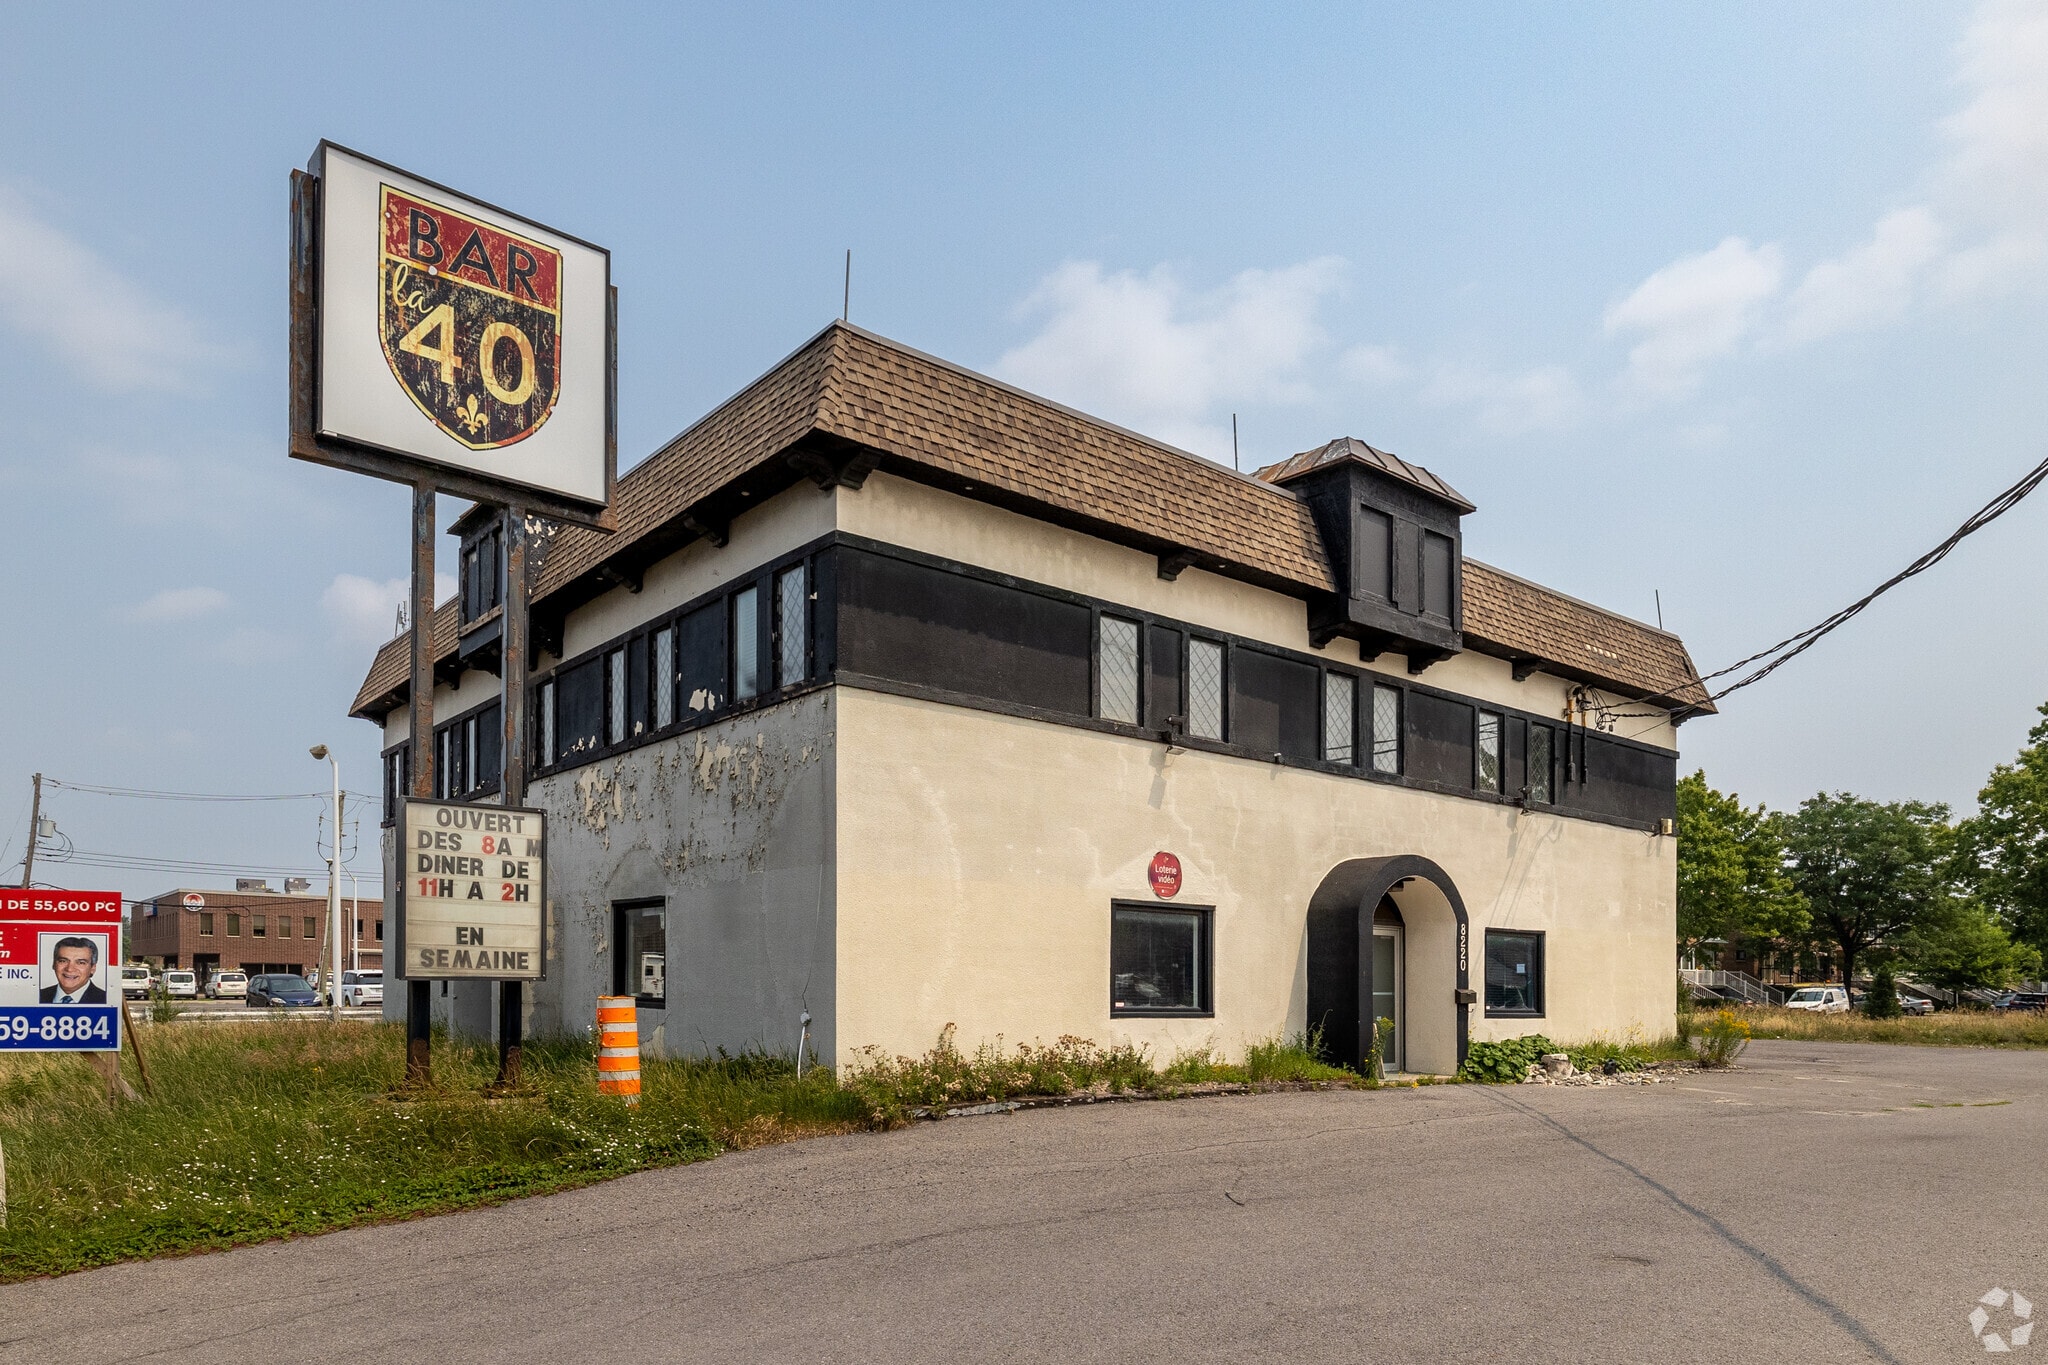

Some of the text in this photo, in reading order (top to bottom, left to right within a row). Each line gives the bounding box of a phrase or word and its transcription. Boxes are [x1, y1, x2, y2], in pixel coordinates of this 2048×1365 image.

[408, 207, 542, 304] BAR
[392, 263, 434, 314] la
[399, 303, 536, 405] 40
[436, 807, 525, 834] OUVERT
[417, 829, 462, 852] DES
[417, 853, 529, 879] DINER DE
[1154, 863, 1177, 875] Loterie
[417, 877, 529, 902] 11H A 2H
[1157, 873, 1175, 884] vidéo
[7, 899, 29, 910] DE
[33, 900, 90, 913] 55,600
[95, 901, 116, 913] PC
[456, 926, 484, 946] EN
[419, 948, 529, 970] SEMAINE
[7, 968, 33, 979] INC.
